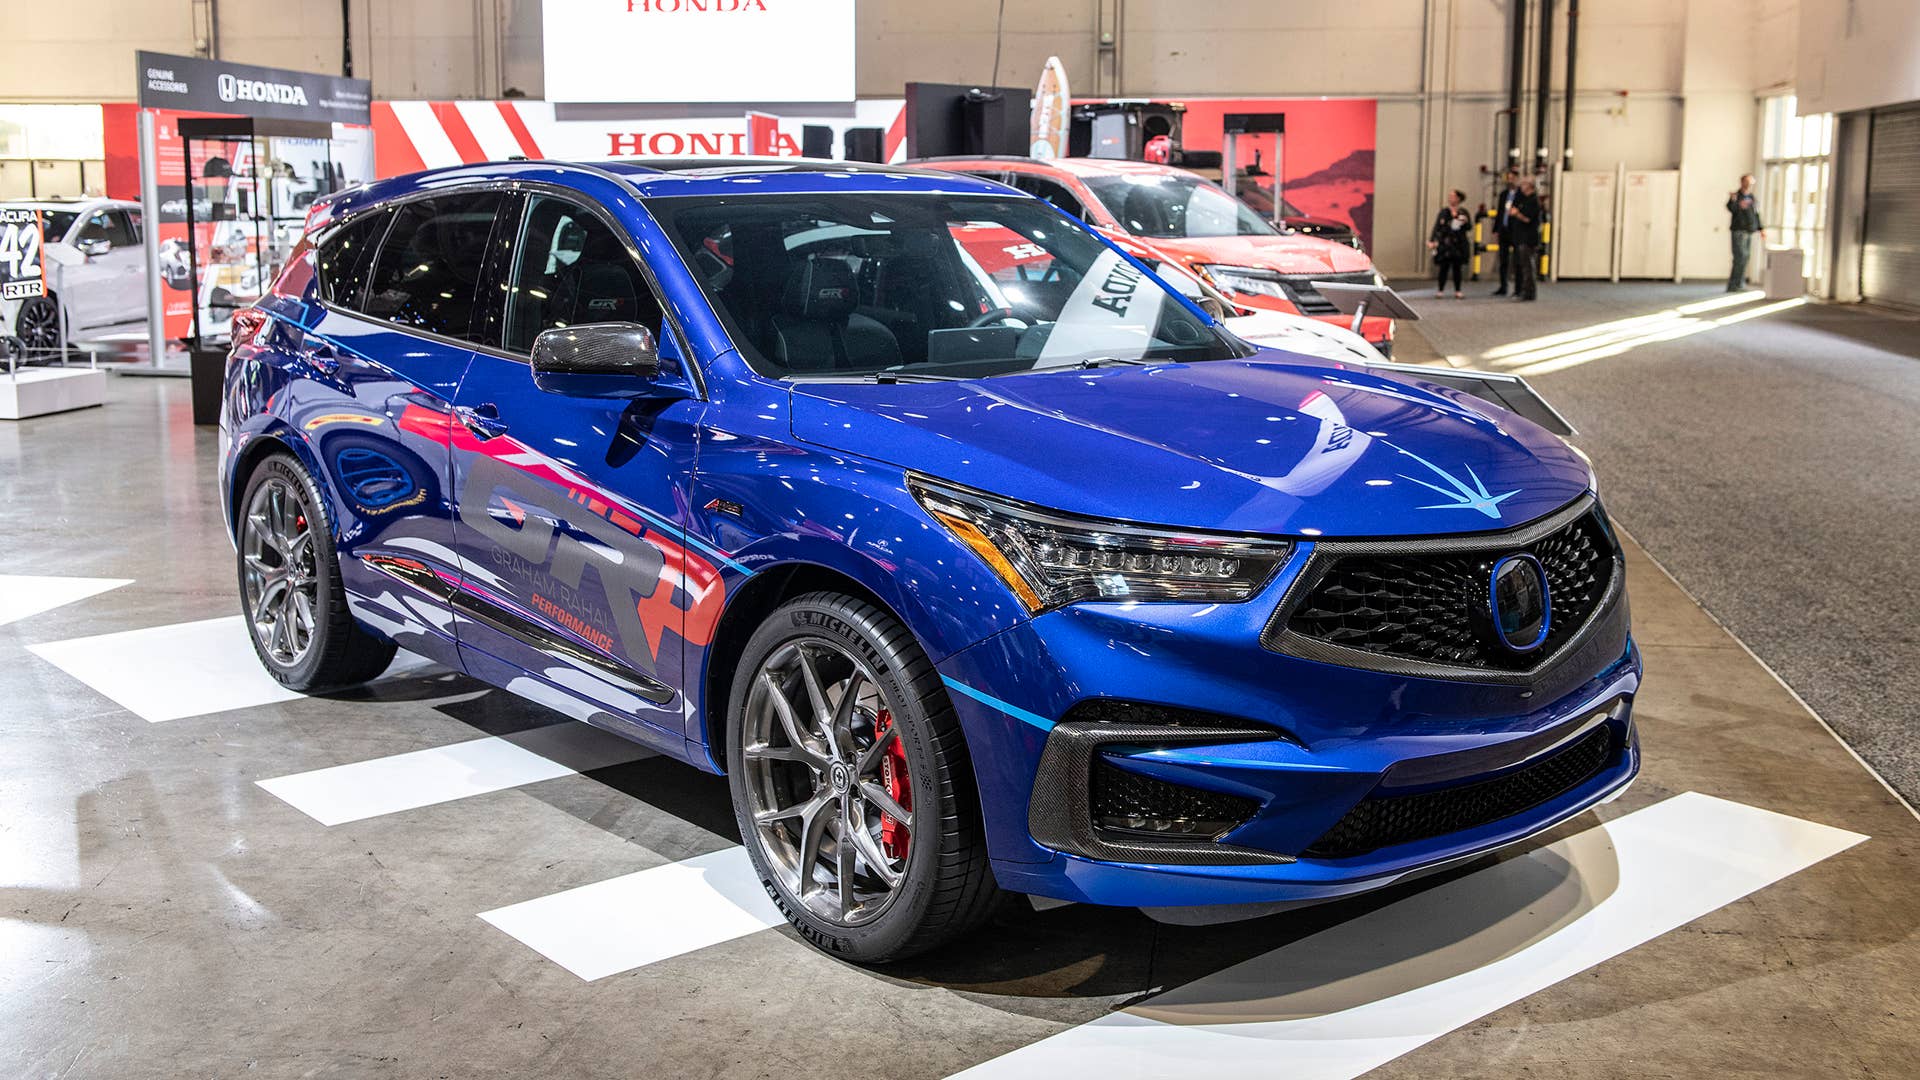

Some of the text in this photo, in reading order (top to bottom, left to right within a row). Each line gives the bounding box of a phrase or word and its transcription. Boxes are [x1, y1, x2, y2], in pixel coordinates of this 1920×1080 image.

[627, 0, 767, 12] HONDA
[237, 80, 308, 105] HONDA
[607, 133, 802, 156] HONA
[0, 223, 41, 278] 42
[6, 283, 41, 296] RTR
[275, 464, 309, 504] MICHELIN
[491, 545, 614, 635] GRAHAM RAHAL
[531, 593, 614, 652] PERFORMANCE
[810, 612, 889, 675] MICHELIN
[889, 678, 907, 708] PILOT
[905, 713, 923, 752] SPORT
[765, 881, 836, 949] MICHELIN
